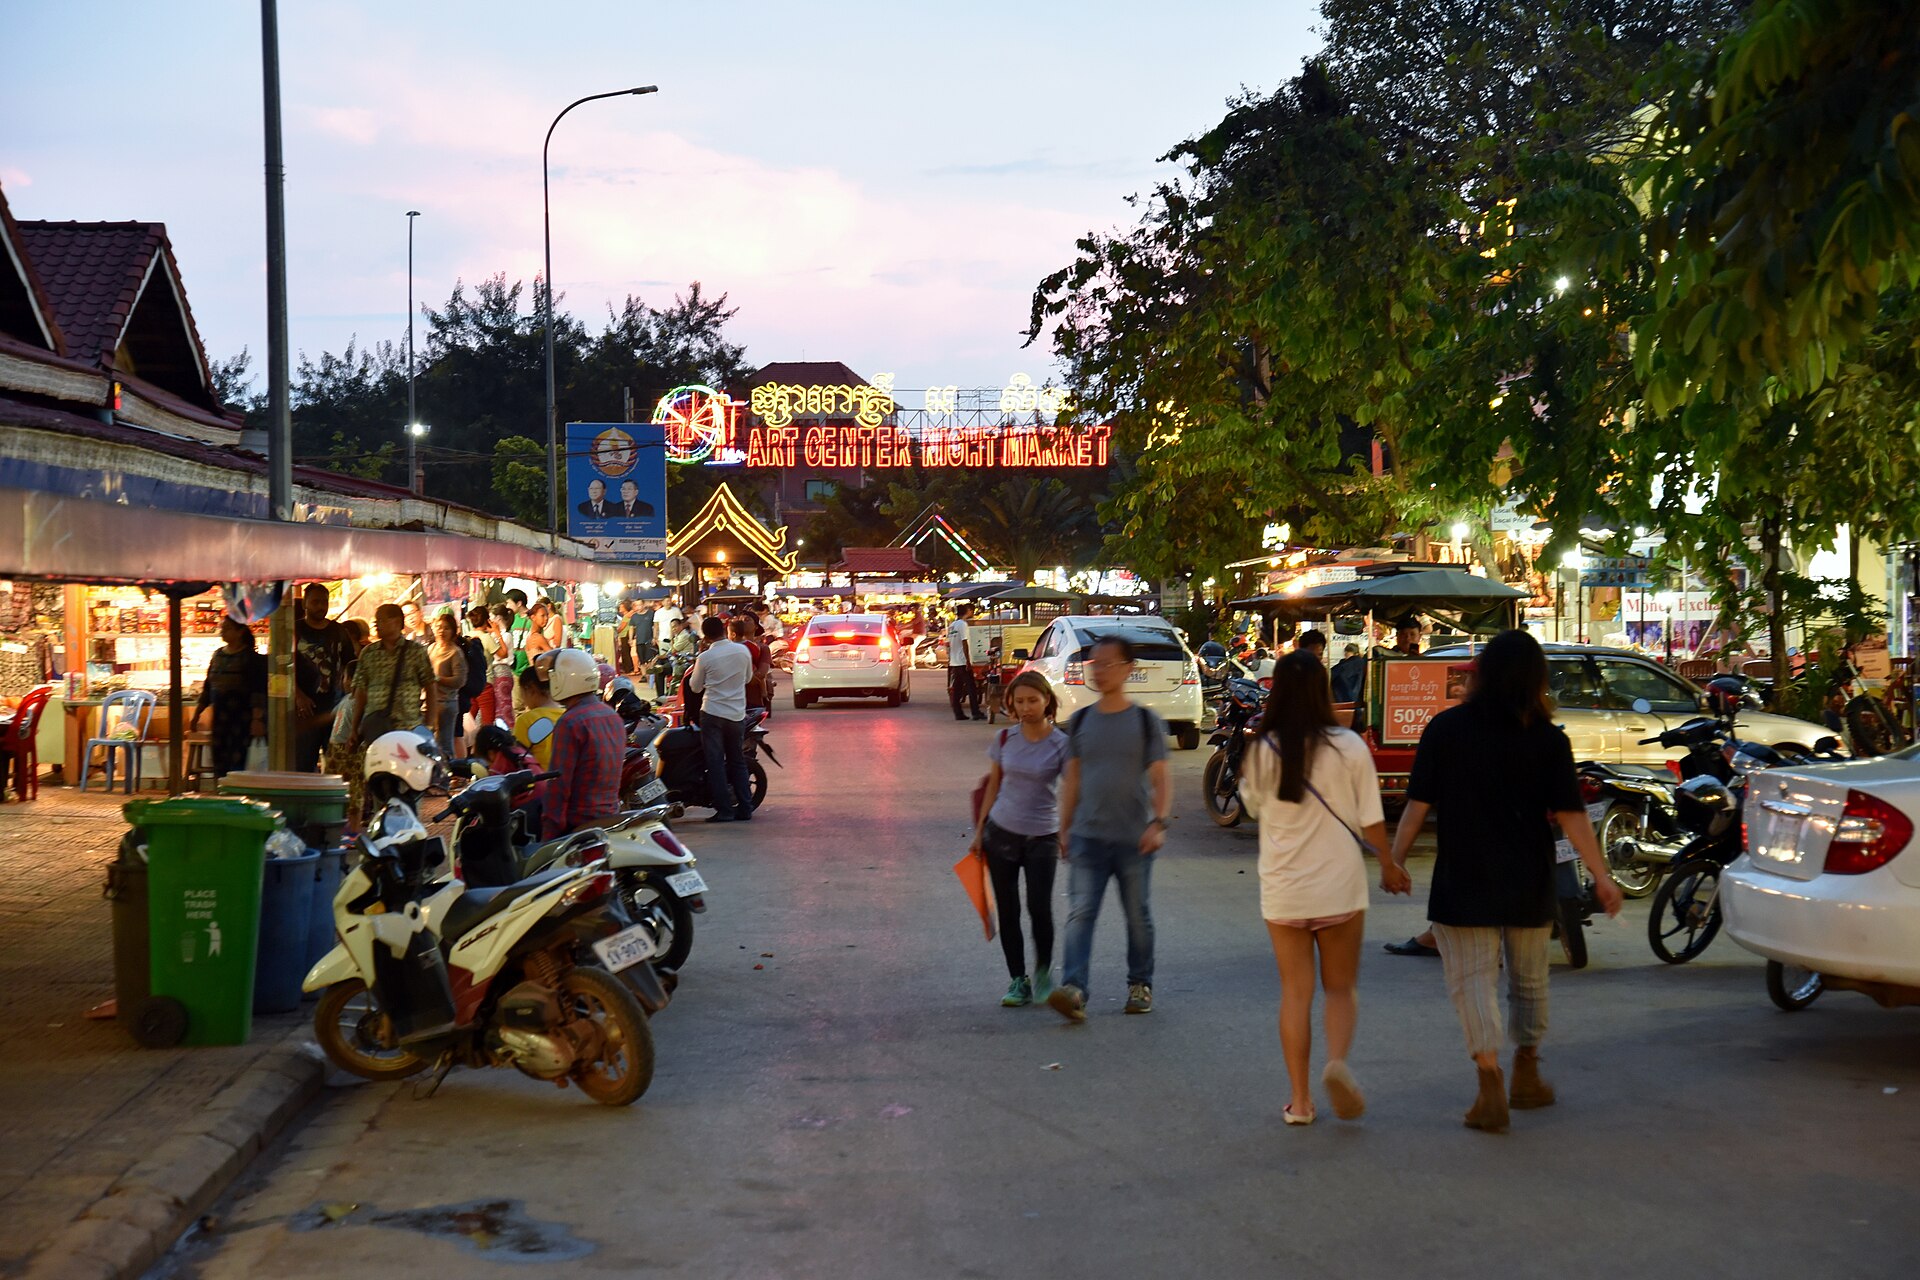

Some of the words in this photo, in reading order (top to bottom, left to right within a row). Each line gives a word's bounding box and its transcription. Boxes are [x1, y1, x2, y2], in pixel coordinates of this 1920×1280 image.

[747, 427, 799, 468] ART
[805, 427, 912, 468] CENTER
[921, 425, 1000, 468] NIGHT
[1001, 424, 1112, 468] MARKET
[1393, 708, 1433, 723] 50%
[1401, 724, 1425, 734] OFF
[186, 911, 213, 919] HERE
